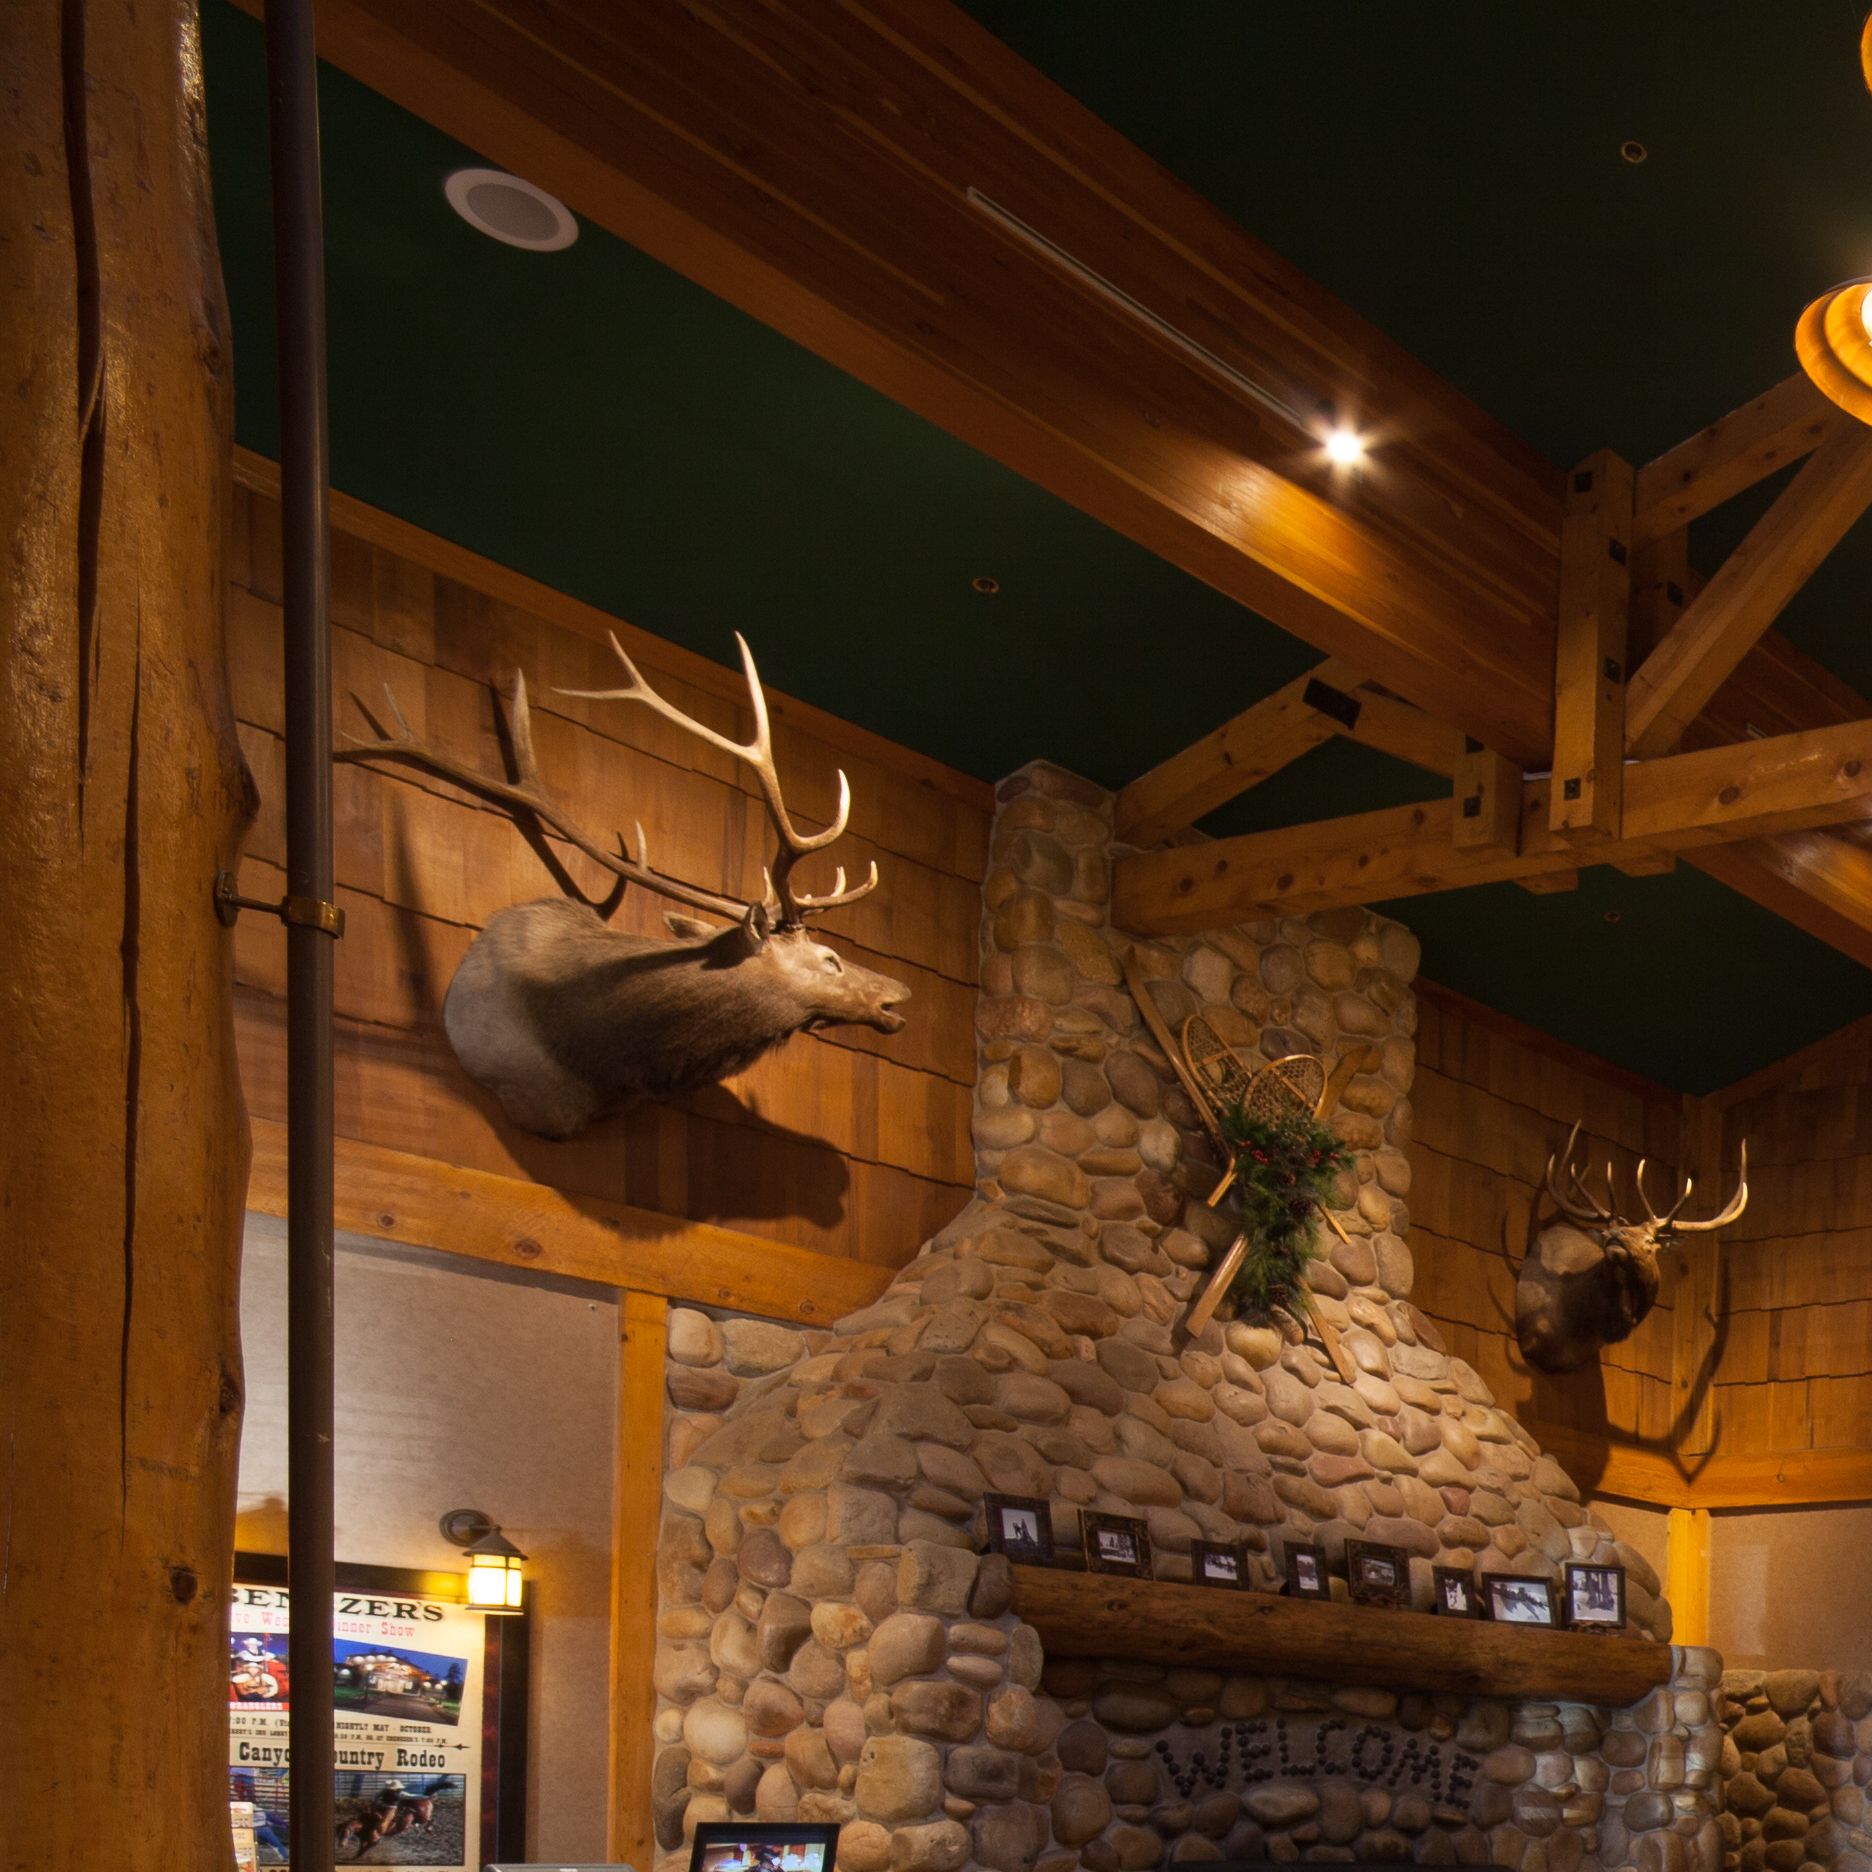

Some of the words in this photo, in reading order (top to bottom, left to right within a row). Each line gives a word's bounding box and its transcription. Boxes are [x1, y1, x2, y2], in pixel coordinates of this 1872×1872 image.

[380, 1621, 415, 1637] Show
[396, 1749, 446, 1767] Rodeo
[1154, 1719, 1480, 1809] WELCOME
